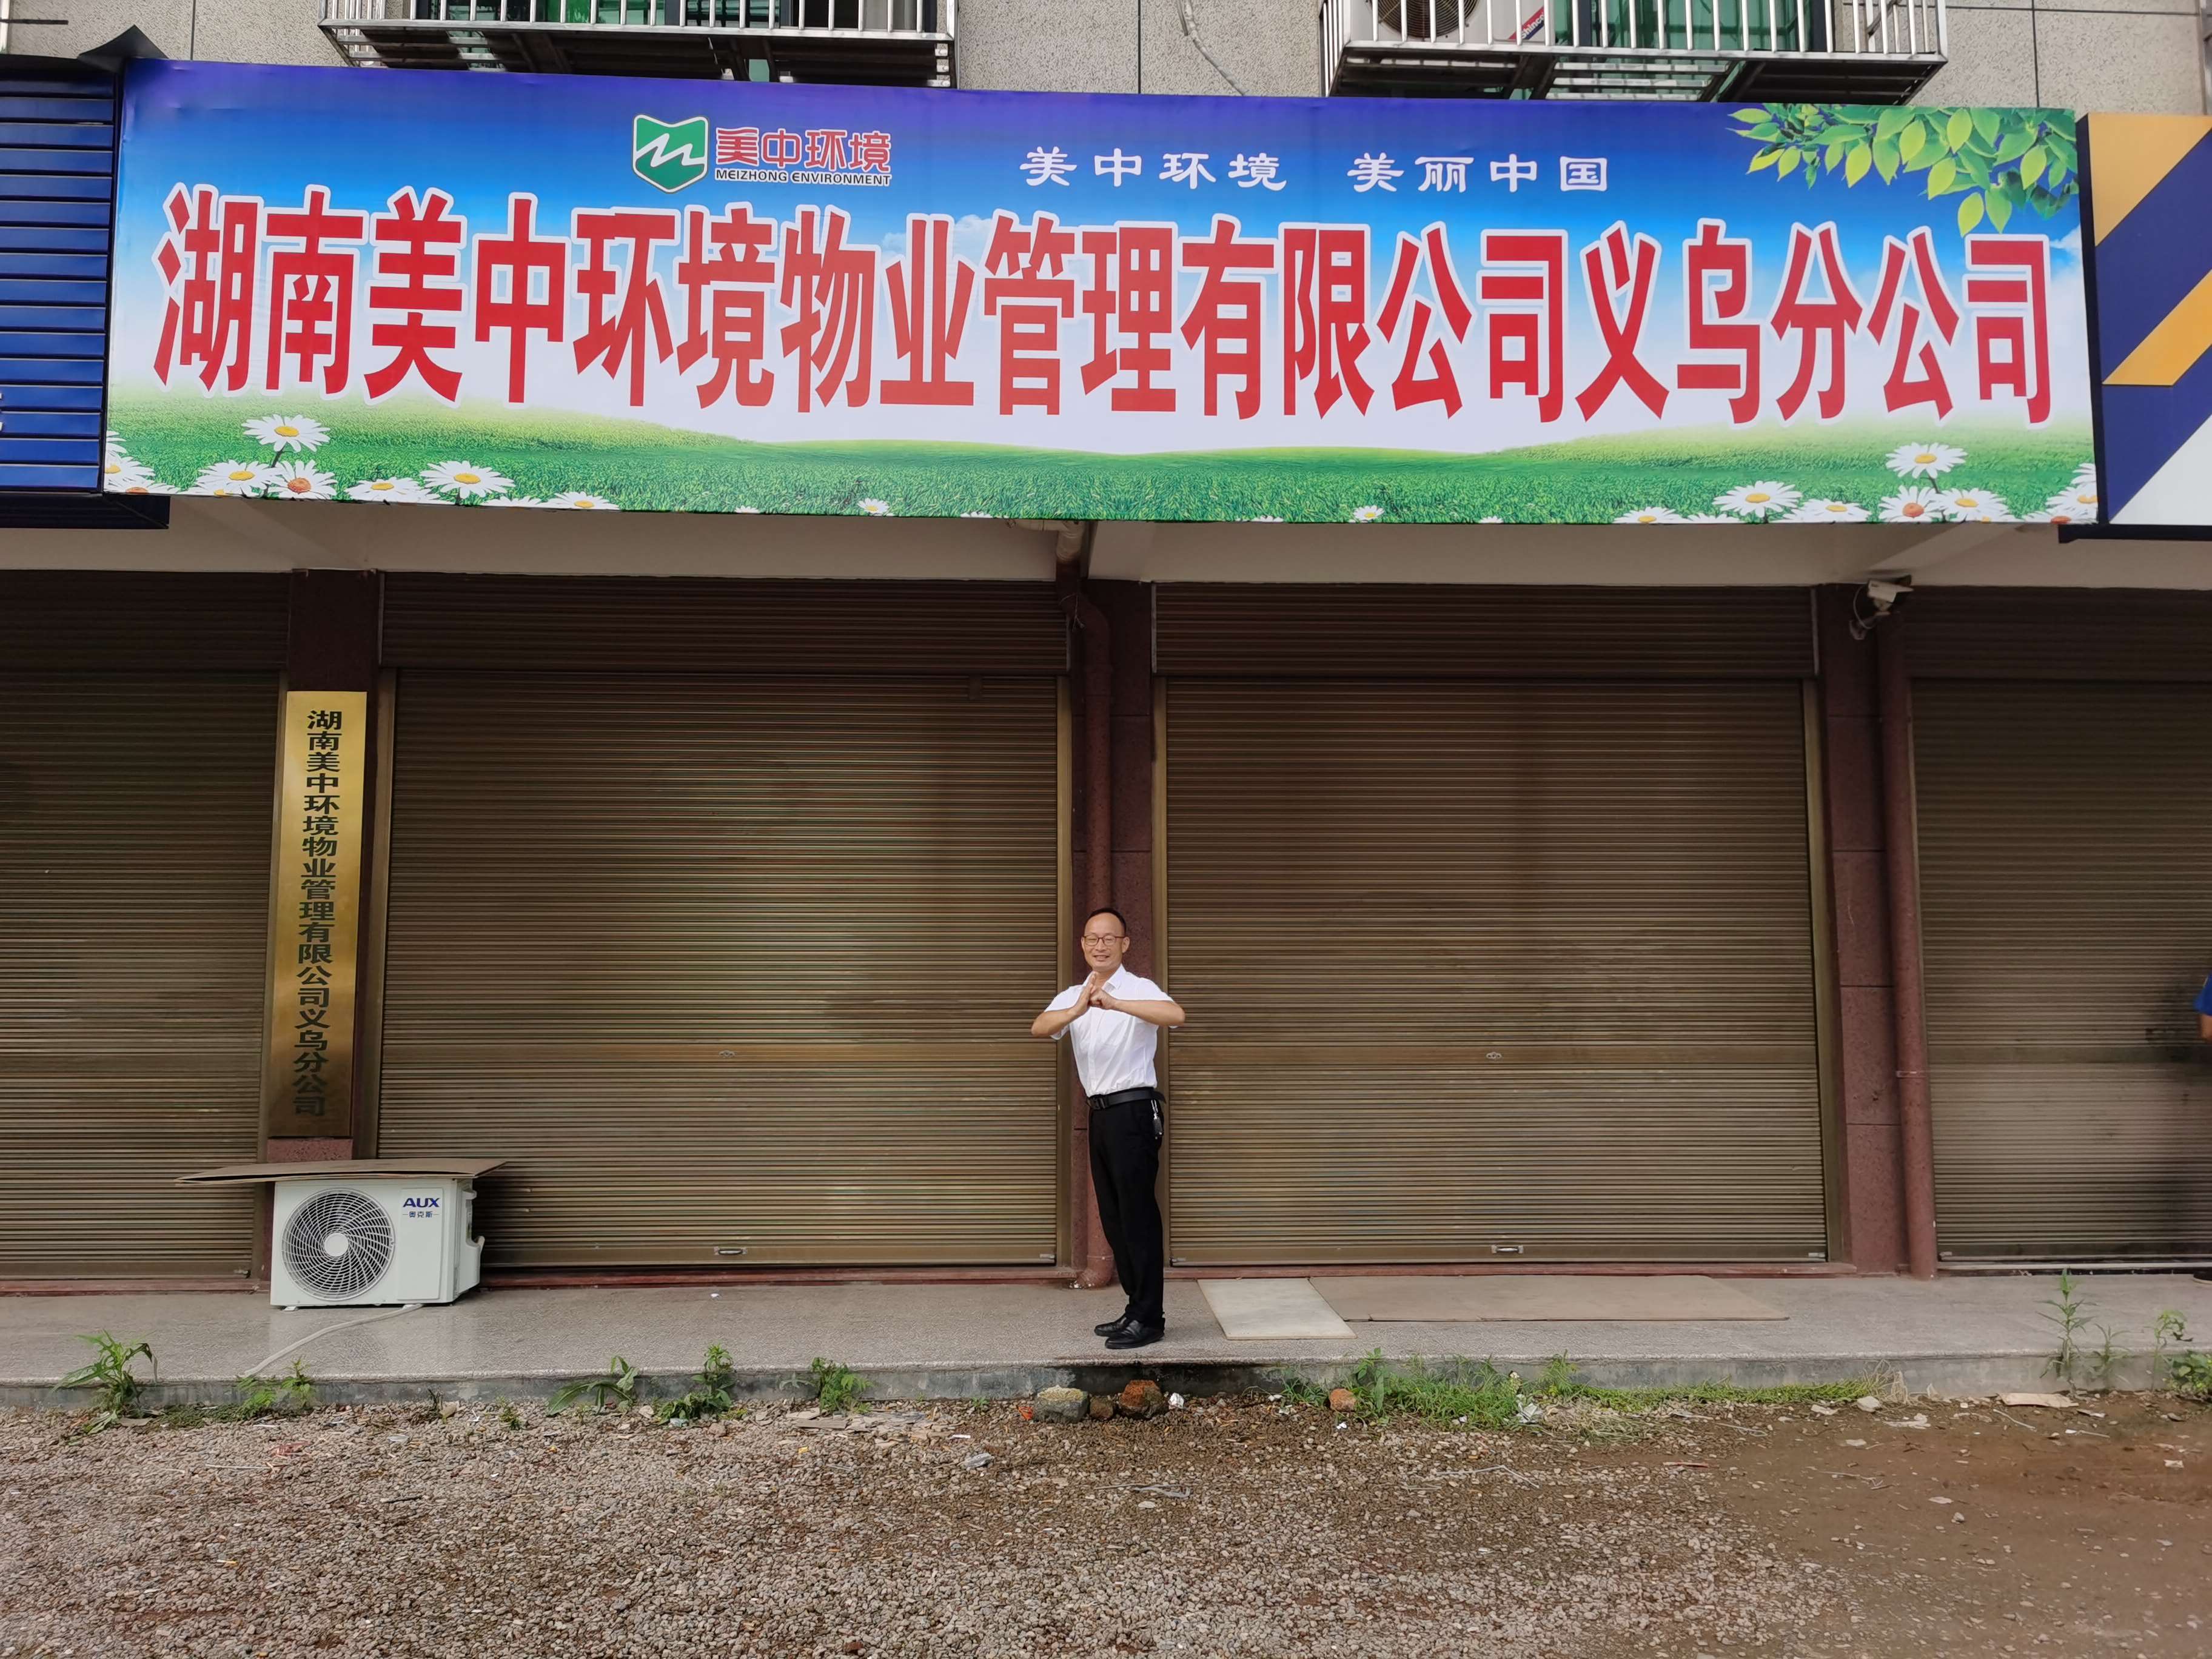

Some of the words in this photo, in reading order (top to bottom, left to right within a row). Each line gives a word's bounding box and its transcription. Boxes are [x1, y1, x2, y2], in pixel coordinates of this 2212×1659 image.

[717, 128, 891, 172] 美中环境
[1019, 146, 1287, 192] 美中环境
[1347, 152, 1608, 193] 美丽中国
[716, 170, 787, 182] MEIZHONG
[791, 172, 890, 185] ENVIRONMENT
[153, 186, 2053, 424] 湖南美中环境物业管理有限公司义乌分公司
[292, 710, 343, 1116] 湖南美中环境物业管理有限公司义乌分公司
[403, 1198, 440, 1208] AUX
